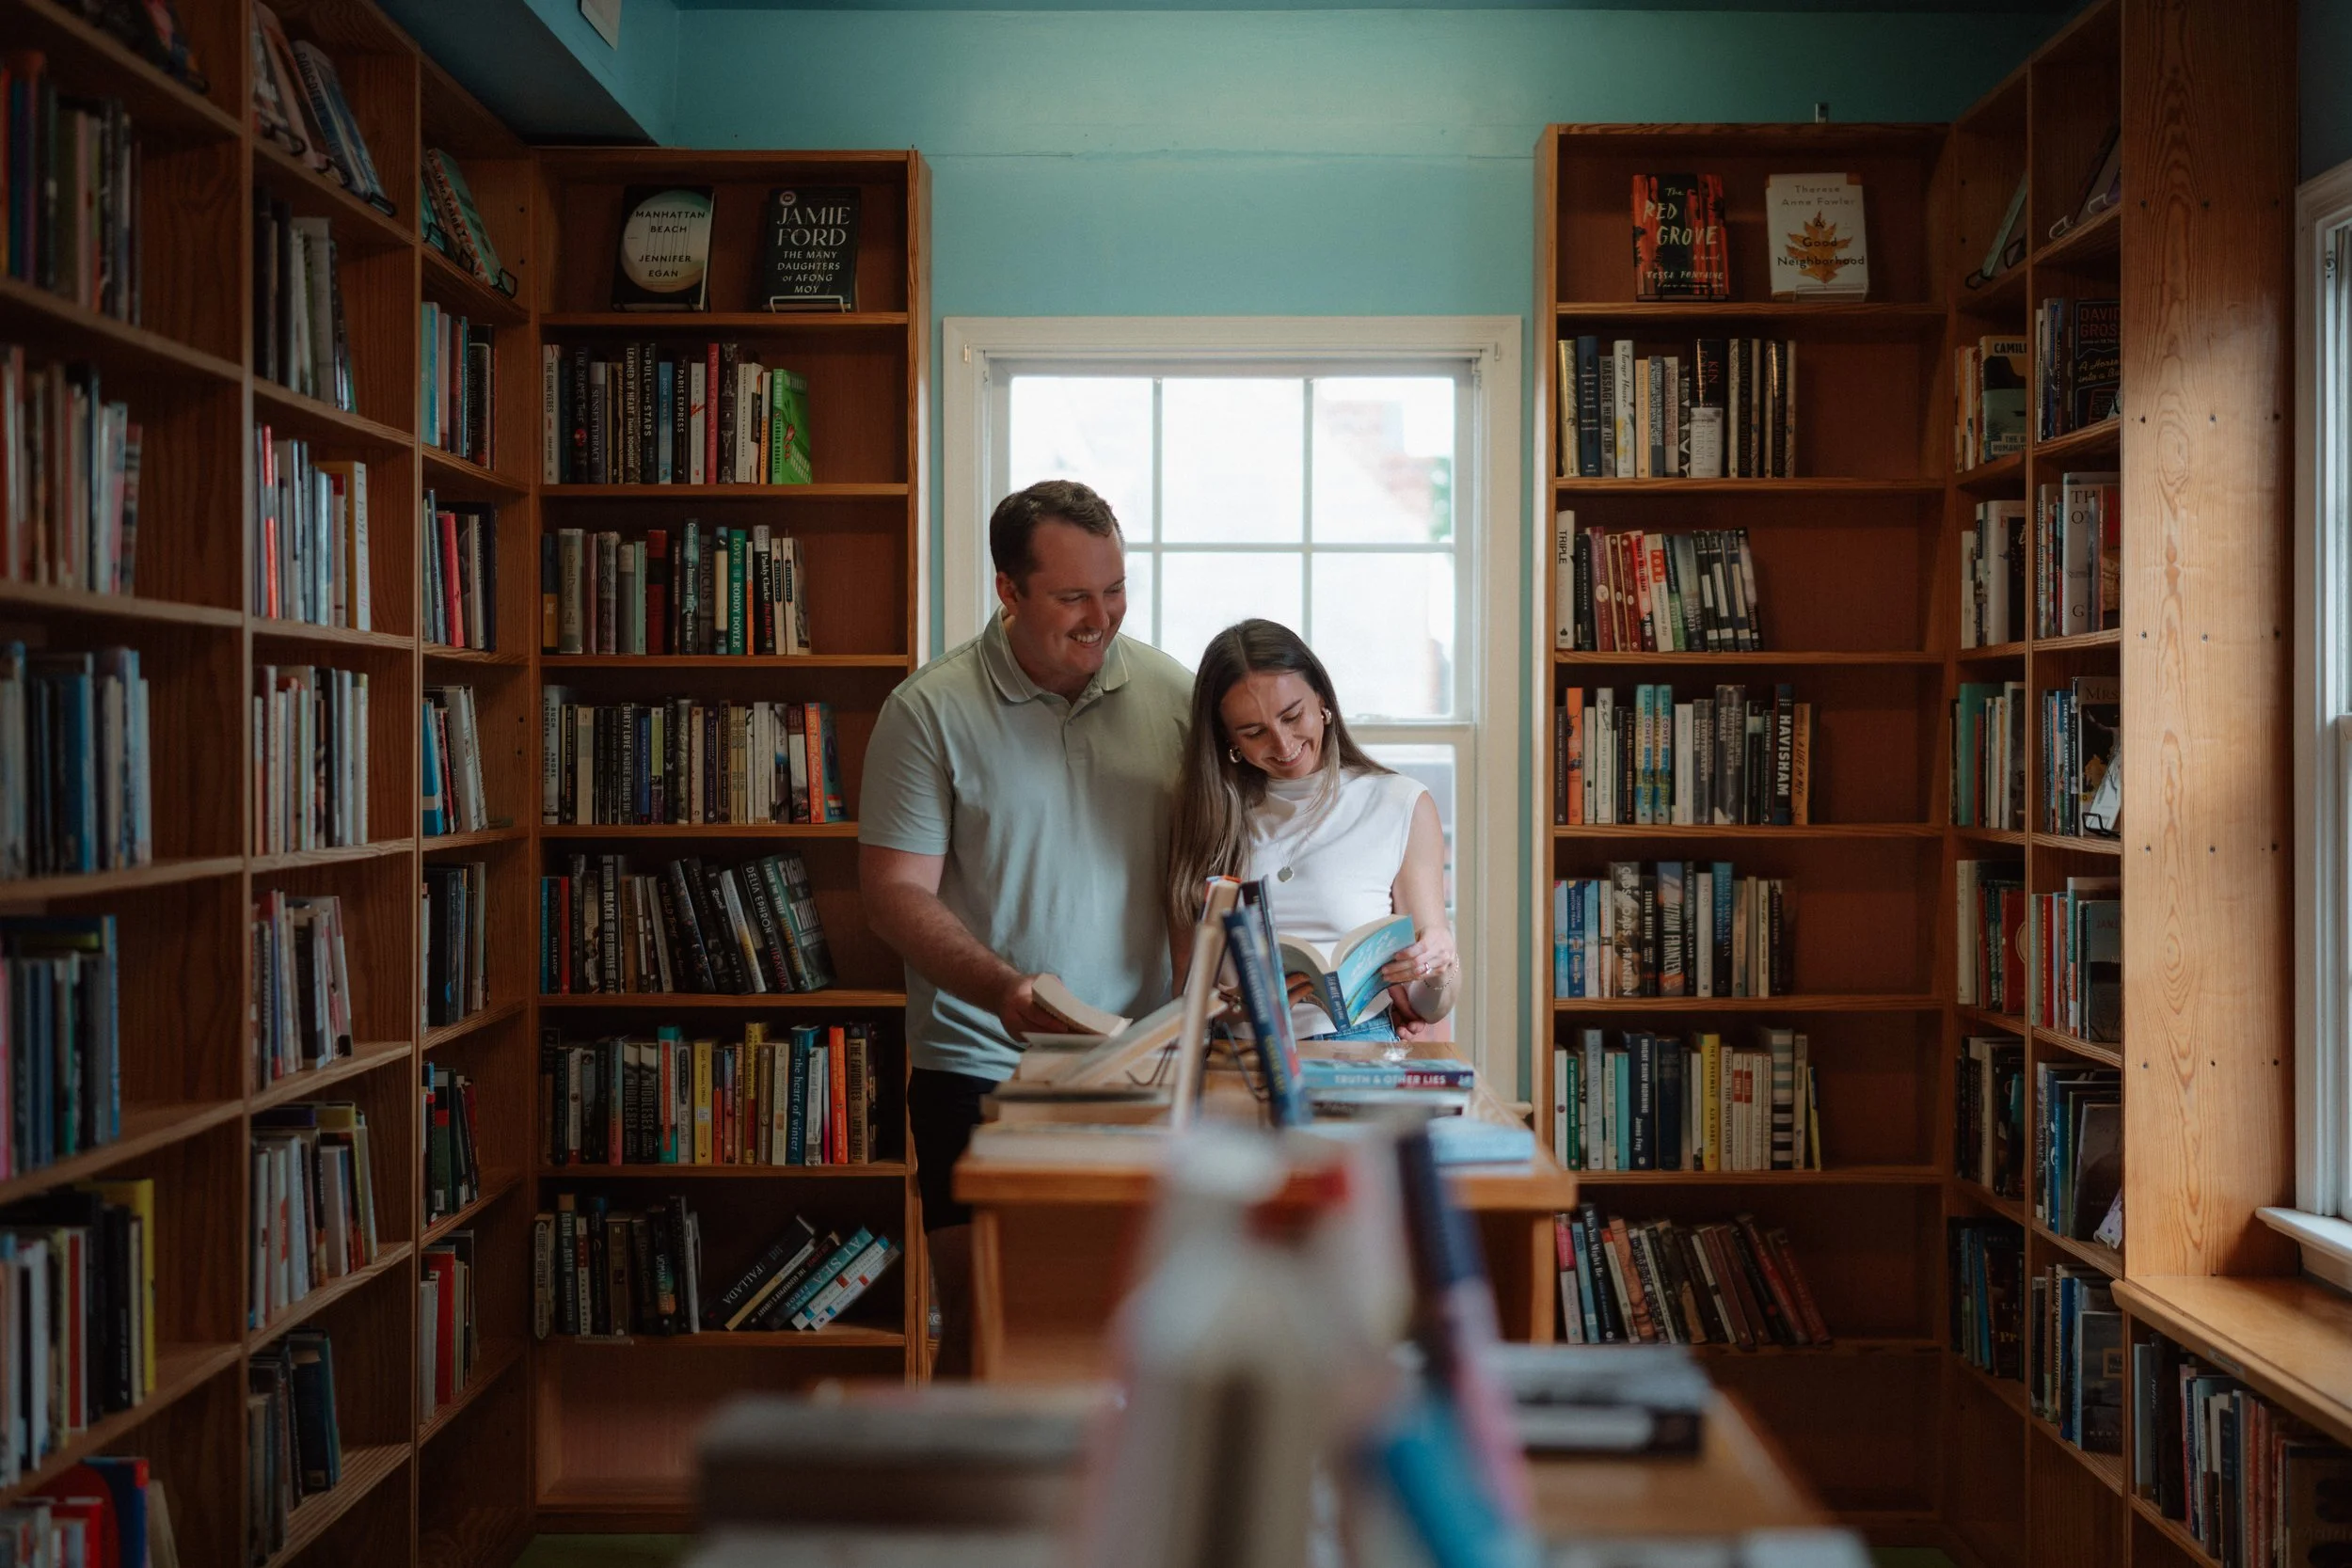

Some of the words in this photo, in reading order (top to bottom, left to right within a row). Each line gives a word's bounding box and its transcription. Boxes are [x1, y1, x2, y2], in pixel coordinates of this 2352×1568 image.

[1665, 187, 1685, 196] The
[777, 207, 850, 225] JAMIE
[1644, 199, 1677, 223] RED
[778, 229, 847, 245] FORD
[1657, 226, 1718, 245] GROVE
[1803, 237, 1837, 246] Good
[1778, 256, 1865, 269] Neighborhood
[2080, 324, 2118, 338] GROS
[1994, 342, 2026, 354] CAMIL
[1708, 361, 1718, 384] KEN
[2078, 360, 2088, 372] A
[2078, 374, 2097, 383] into
[2107, 368, 2121, 377] Ba
[627, 381, 634, 389] BY
[1602, 361, 1612, 404] MASSAGE
[1622, 380, 1630, 403] House
[627, 392, 635, 414] HEART
[1603, 406, 1612, 429] HENRY
[1604, 432, 1613, 453] FLESH
[733, 538, 741, 564] LOVE
[1558, 531, 1567, 564] TRIPLE
[701, 543, 712, 600] MEDICUS
[760, 554, 769, 576] Paddy
[1652, 551, 1664, 582] FORD
[732, 582, 740, 614] RODDY
[623, 707, 631, 729] DIRTY
[623, 731, 631, 750] LOVE
[623, 752, 631, 775] ANDRE
[1777, 715, 1791, 796] HAVISHAM
[1796, 749, 1804, 765] LIFE
[1797, 768, 1804, 777] IN
[623, 777, 631, 801] DUBUS
[745, 865, 762, 894] DELIA
[755, 895, 773, 934] EPHRON
[763, 863, 776, 883] FAGIN
[774, 896, 786, 914] THIEF
[603, 892, 614, 920] BLACK
[1621, 866, 1632, 937] CROSSROADS
[1663, 934, 1682, 977] FRANZEN
[1622, 947, 1633, 996] FRANZEN
[1245, 957, 1269, 1023] Intentions
[850, 1041, 861, 1055] THE
[1641, 1038, 1649, 1061] BRIGHT
[794, 1058, 803, 1073] the
[1641, 1063, 1649, 1082] SHINY
[793, 1076, 803, 1103] heart
[850, 1059, 863, 1101] FAVORITES
[1334, 1074, 1370, 1085] TRUTH
[1373, 1075, 1380, 1085] &
[1383, 1074, 1421, 1085] OTHER
[1422, 1074, 1446, 1085] LIES
[625, 1079, 637, 1129] MIDDLESEX
[641, 1080, 653, 1130] MIDDLESEX
[792, 1105, 803, 1115] of
[1641, 1083, 1649, 1114] MORNING
[790, 1119, 802, 1151] winter
[851, 1116, 863, 1137] LAYNE
[1635, 1117, 1644, 1136] James
[1633, 1138, 1644, 1151] Frey
[561, 1212, 573, 1236] AGAIN
[1584, 1210, 1595, 1227] Who
[841, 1235, 862, 1256] AT
[1588, 1228, 1597, 1242] You
[564, 1249, 574, 1272] AGAIN
[1591, 1243, 1602, 1266] Might
[810, 1254, 842, 1287] SEA
[1595, 1268, 1604, 1277] Be
[721, 1263, 763, 1307] FALLADA
